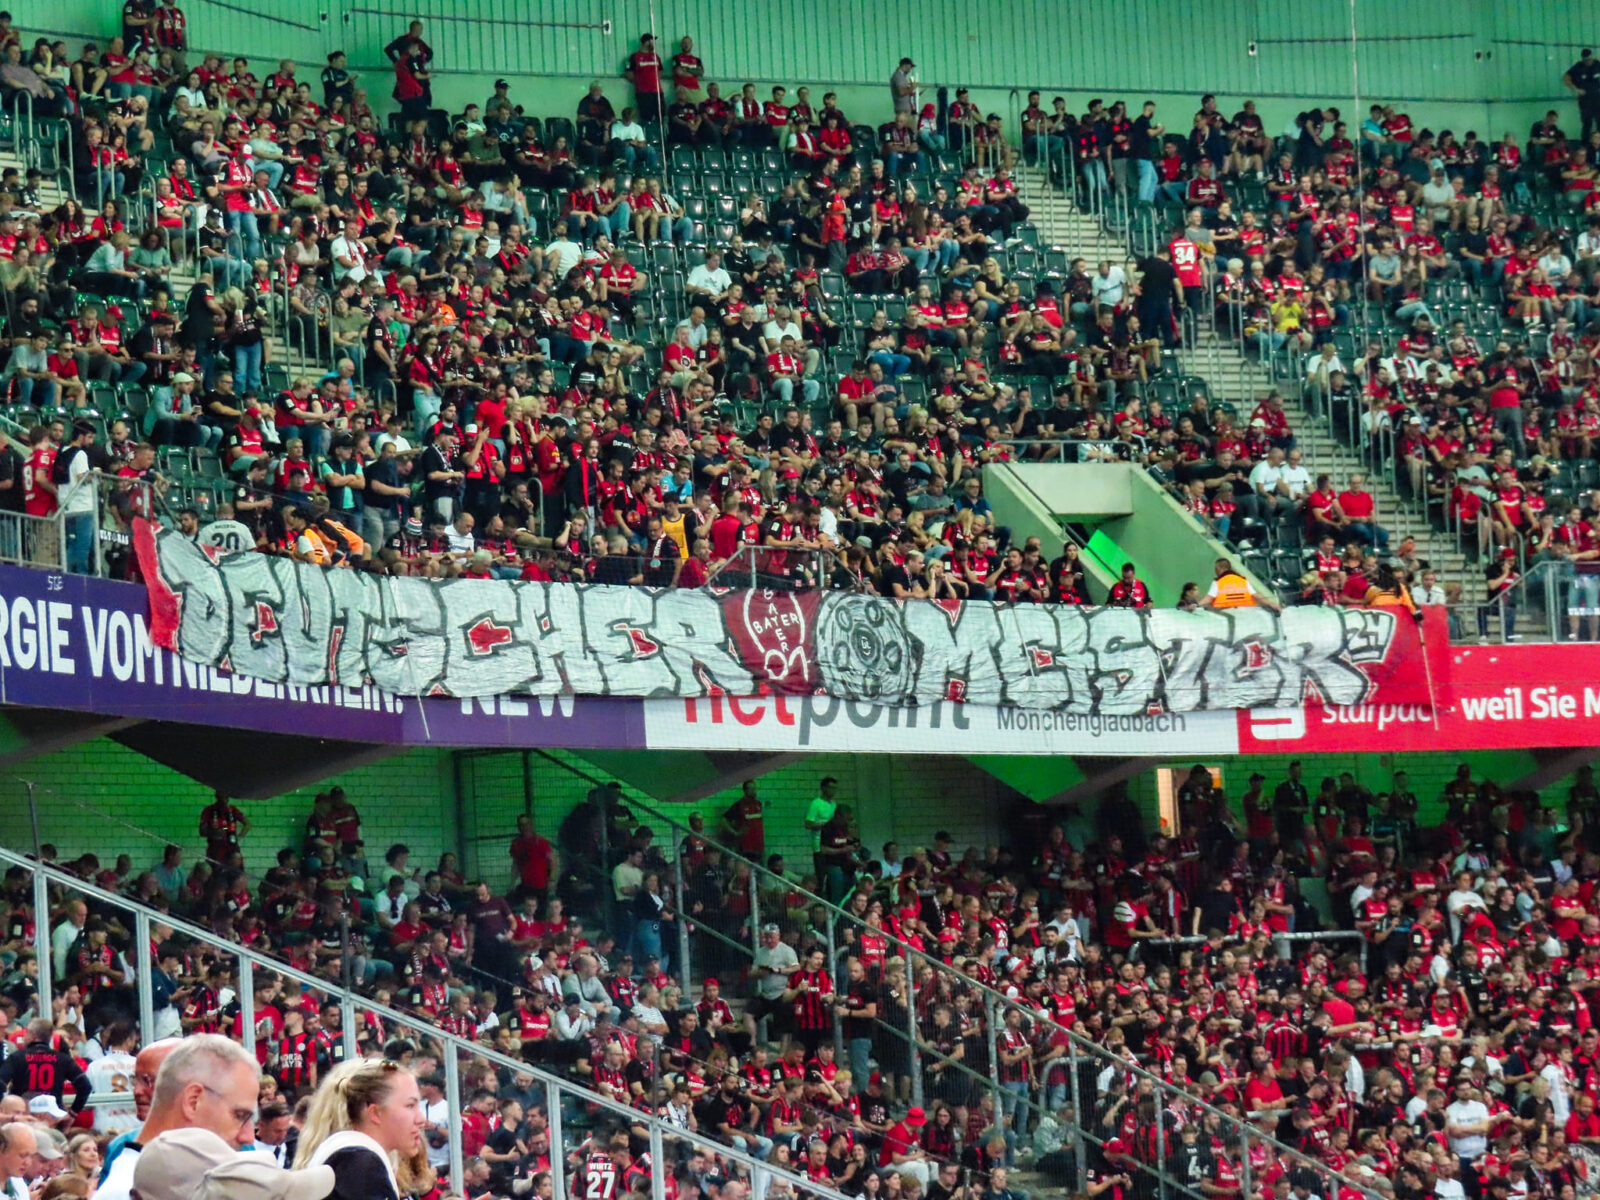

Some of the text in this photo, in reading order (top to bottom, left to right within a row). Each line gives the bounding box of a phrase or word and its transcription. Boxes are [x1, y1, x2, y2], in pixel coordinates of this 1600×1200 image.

[1174, 246, 1195, 265] 34
[211, 532, 240, 551] 20
[160, 524, 756, 698] DEUTSCHER
[1461, 687, 1522, 721] weil
[1530, 686, 1576, 719] Sie
[27, 1063, 55, 1090] 10
[588, 1162, 613, 1171] WIRTZ
[586, 1171, 616, 1199] 27
